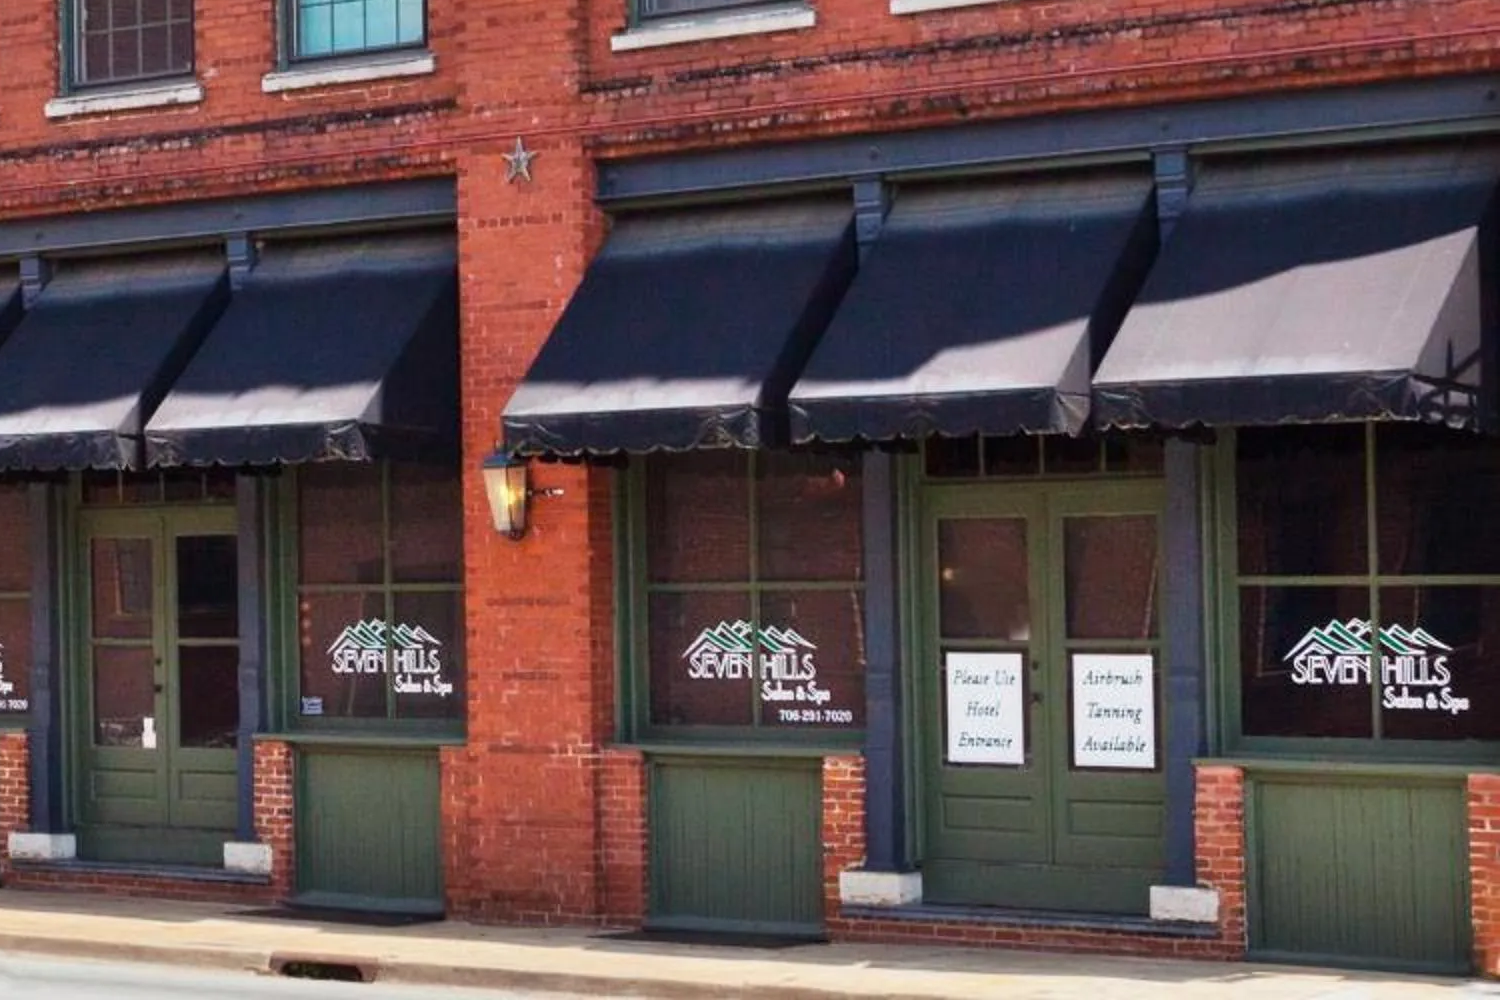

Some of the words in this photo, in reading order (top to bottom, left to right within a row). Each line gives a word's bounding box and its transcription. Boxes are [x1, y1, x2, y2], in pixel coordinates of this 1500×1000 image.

[332, 649, 387, 673] SEVEN
[394, 649, 441, 673] HILLS
[688, 653, 753, 679] SEVEN
[760, 653, 817, 680] HILLS
[1291, 655, 1371, 684] SEVEN
[1381, 656, 1451, 686] HILLS
[953, 670, 990, 686] Please
[995, 670, 1016, 686] Use
[1082, 669, 1143, 686] Airbrush
[966, 702, 1001, 717] Hotel
[1382, 686, 1424, 709] Salon
[1425, 692, 1438, 709] &
[1439, 687, 1470, 715] Spa
[1087, 702, 1143, 724] Tanning
[958, 732, 1014, 749] Entrance
[1081, 734, 1147, 753] Available
